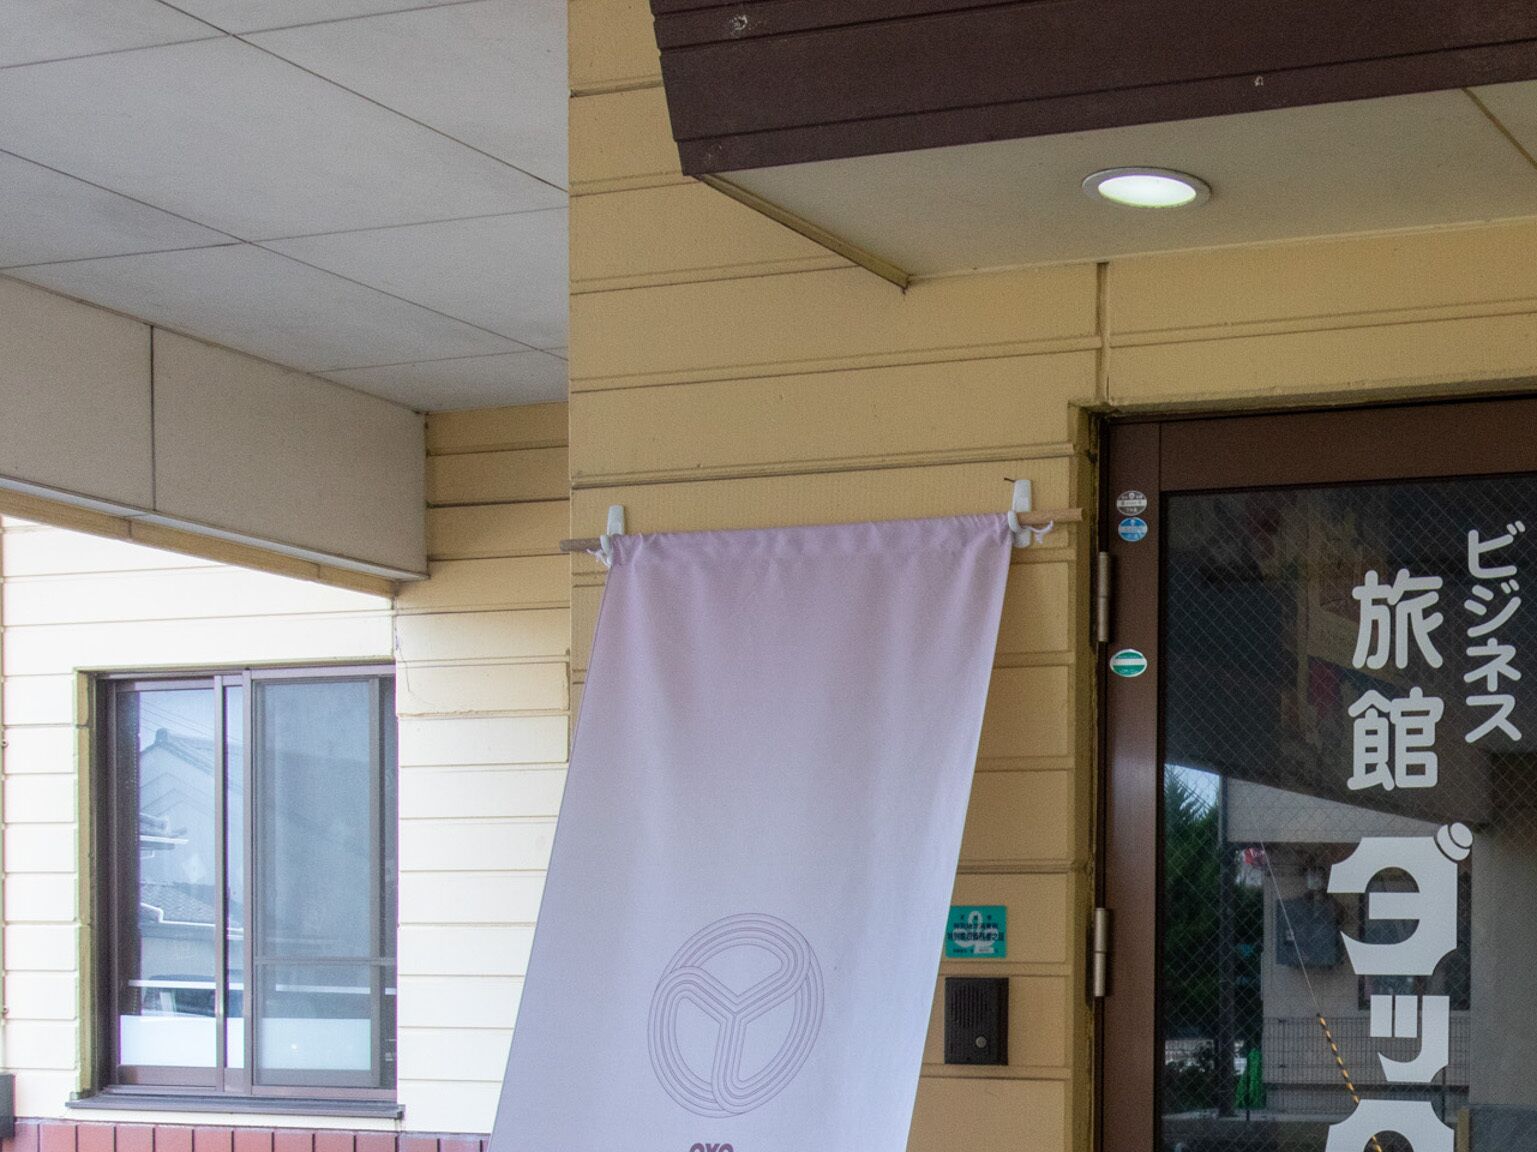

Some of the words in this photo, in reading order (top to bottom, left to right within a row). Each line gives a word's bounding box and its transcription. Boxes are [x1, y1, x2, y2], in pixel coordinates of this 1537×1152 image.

[1347, 568, 1444, 791] 旅館
[1464, 520, 1525, 743] ビジネス
